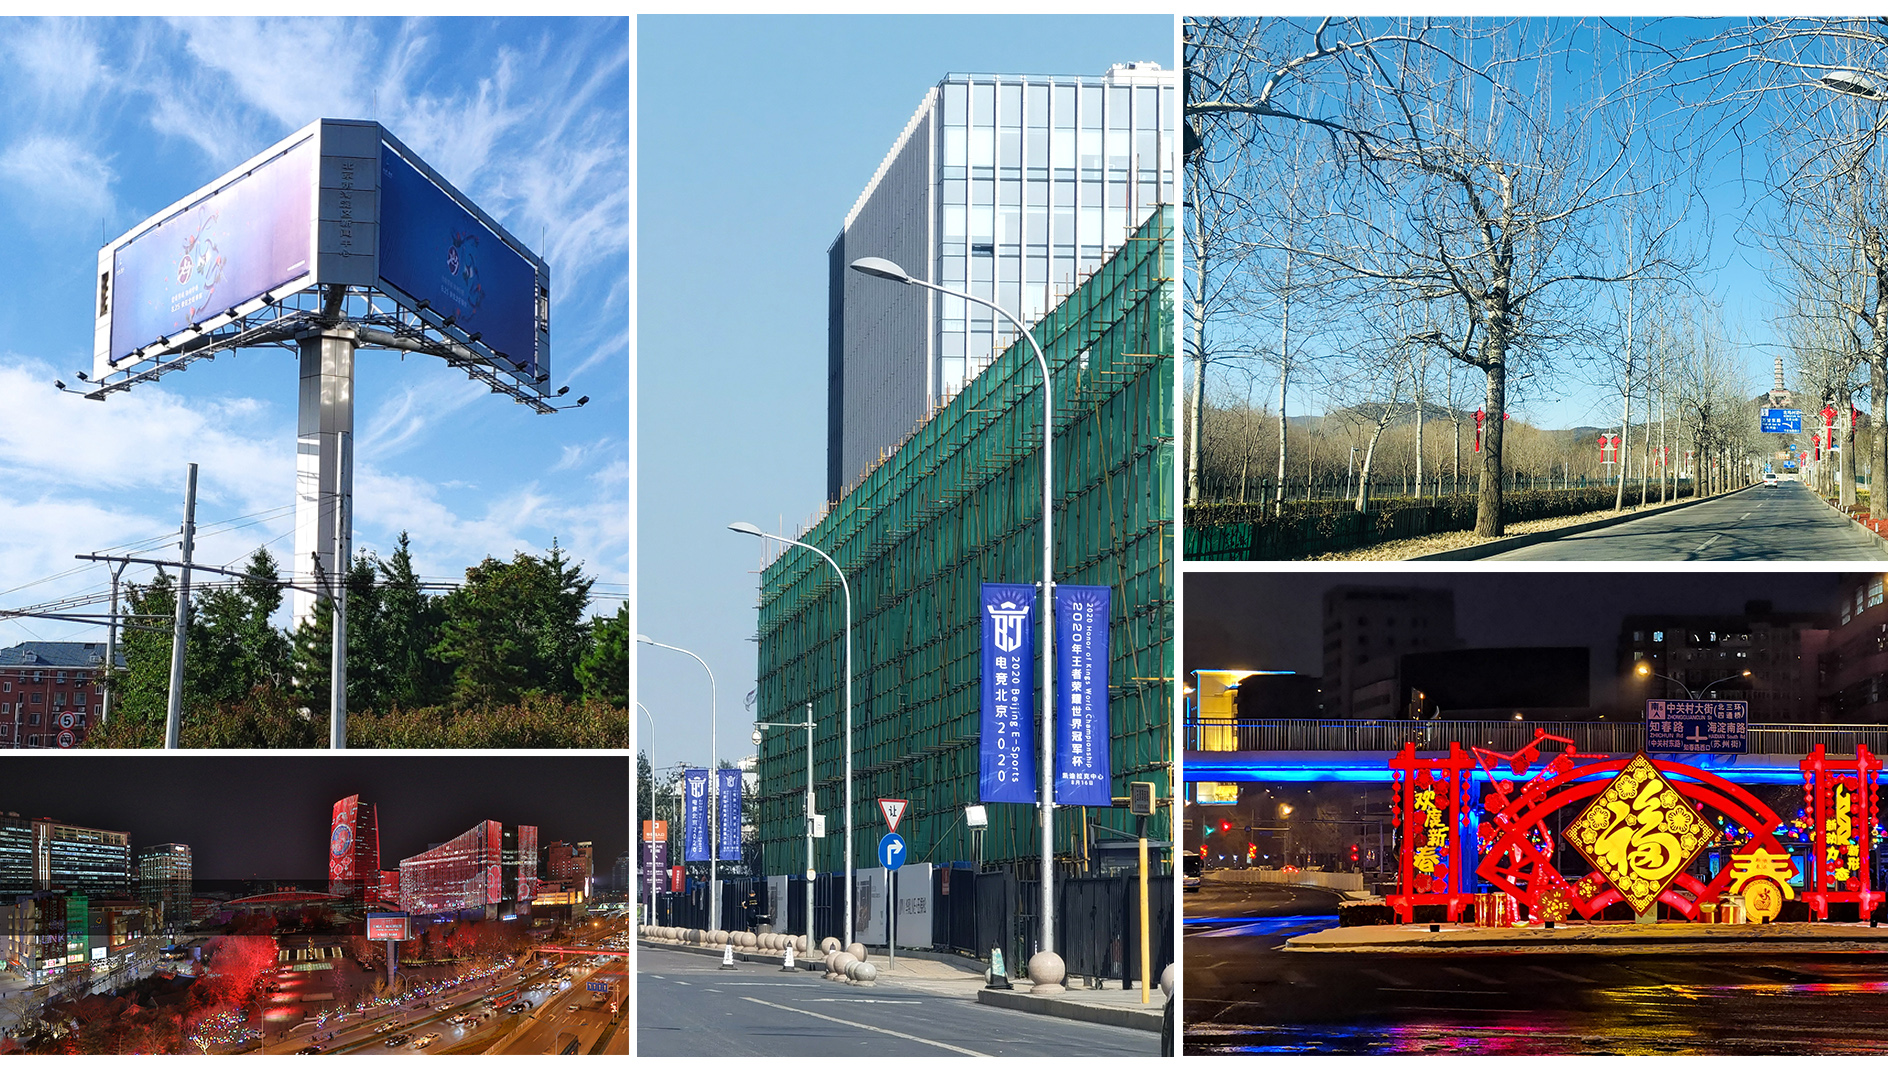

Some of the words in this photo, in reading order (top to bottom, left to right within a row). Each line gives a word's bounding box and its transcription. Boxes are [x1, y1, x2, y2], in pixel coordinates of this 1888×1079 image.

[339, 161, 355, 258] 北京市海淀区新闻中心
[1086, 603, 1094, 623] 2020
[1085, 626, 1093, 650] Honor
[1011, 656, 1021, 684] 2020
[1085, 652, 1092, 661] of
[1071, 602, 1083, 767] 2020年王者荣耀世界冠军杯
[1084, 663, 1092, 685] Kings
[63, 715, 71, 726] 5
[995, 656, 1008, 782] 电竞北京2020
[1009, 688, 1021, 727] Beijing
[1667, 702, 1714, 715] 中关村大街
[1084, 714, 1093, 768] Championship
[1649, 721, 1684, 733] 知春路
[1707, 721, 1746, 734] 海淀南路
[1011, 732, 1021, 783] E-Sports
[888, 805, 897, 817] 让
[1413, 790, 1450, 873] 欢度新春
[1594, 779, 1682, 880] 福
[1729, 847, 1795, 900] 春
